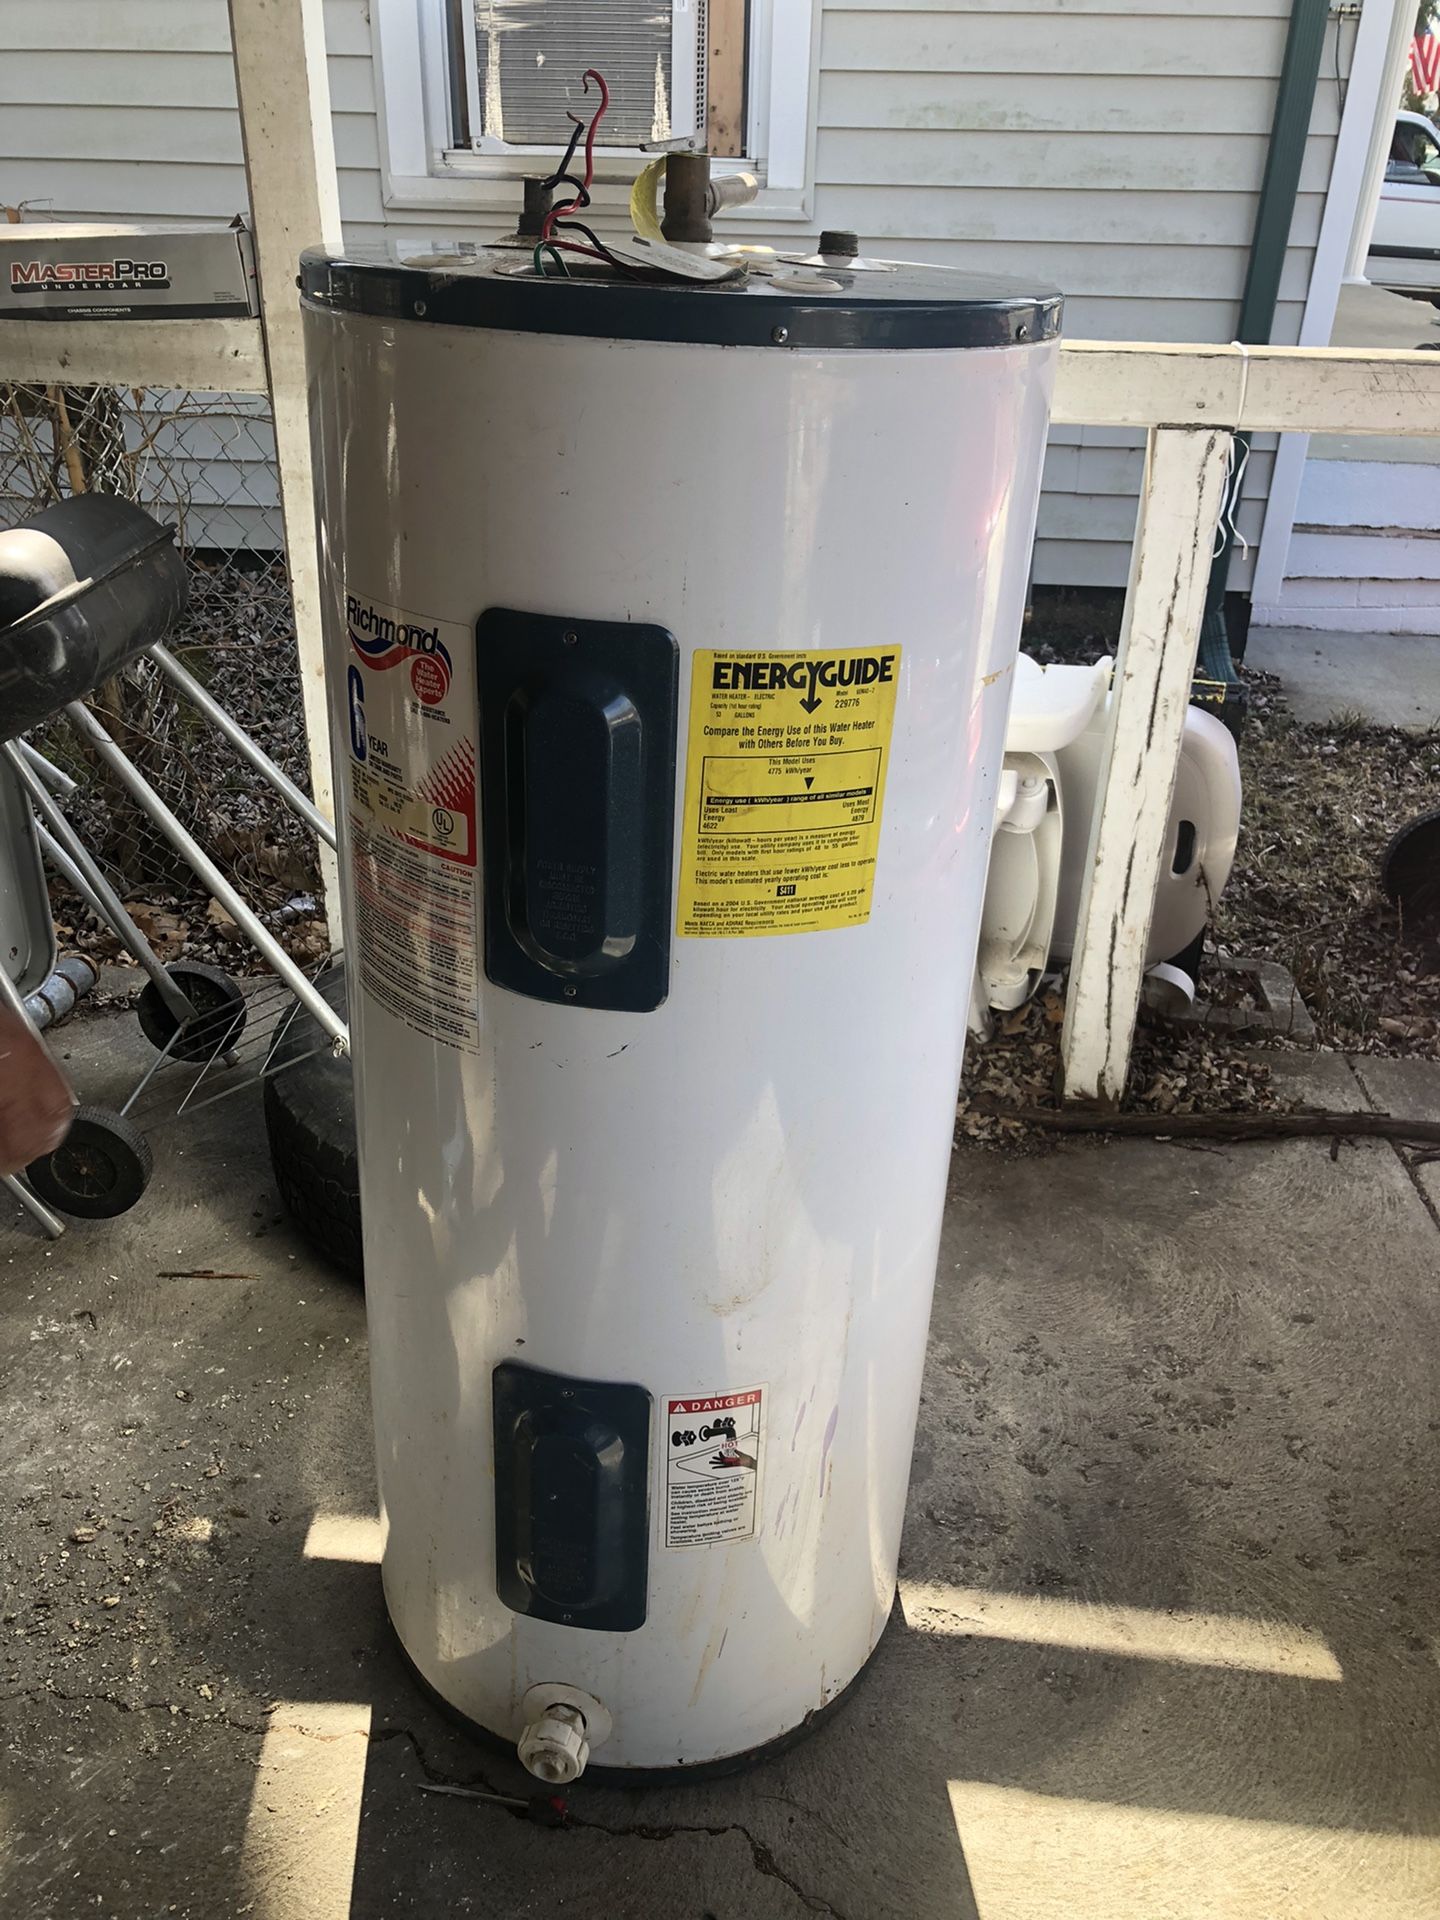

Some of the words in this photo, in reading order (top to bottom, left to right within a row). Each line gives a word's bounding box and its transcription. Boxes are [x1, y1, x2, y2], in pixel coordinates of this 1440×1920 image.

[41, 281, 142, 291] UNDERCAR
[347, 595, 439, 655] Richmond
[416, 667, 438, 681] Water
[712, 655, 896, 690] ENERGYGUIDE
[415, 675, 441, 690] Heater
[834, 698, 860, 709] 229776
[347, 664, 367, 761] 6
[703, 725, 739, 738] Compare
[742, 726, 754, 736] the
[757, 726, 785, 738] Energy
[787, 725, 801, 735] Use
[804, 724, 812, 735] of
[814, 723, 827, 734] this
[830, 722, 850, 733] Water
[852, 720, 875, 731] Heater
[367, 734, 389, 757] YEAR
[738, 738, 756, 749] with
[757, 738, 783, 749] Others
[785, 738, 810, 748] Before
[813, 737, 827, 747] You
[829, 735, 845, 747] Buy.
[801, 757, 816, 765] Uses
[785, 766, 812, 776] kWh/year
[710, 798, 734, 806] Energy
[790, 796, 809, 804] range
[826, 792, 845, 800] similar
[846, 790, 867, 798] models
[842, 800, 856, 808] Uses
[703, 806, 720, 814] Uses
[721, 806, 738, 814] Least
[850, 807, 869, 815] Energy
[703, 814, 726, 822] Energy
[440, 863, 473, 878] CAUTION
[696, 869, 718, 877] Electric
[784, 867, 800, 875] fewer
[801, 865, 827, 873] kWh/year
[695, 877, 708, 885] This
[764, 876, 782, 884] yearly
[691, 1394, 756, 1411] DANGER
[721, 1440, 739, 1449] HOT
